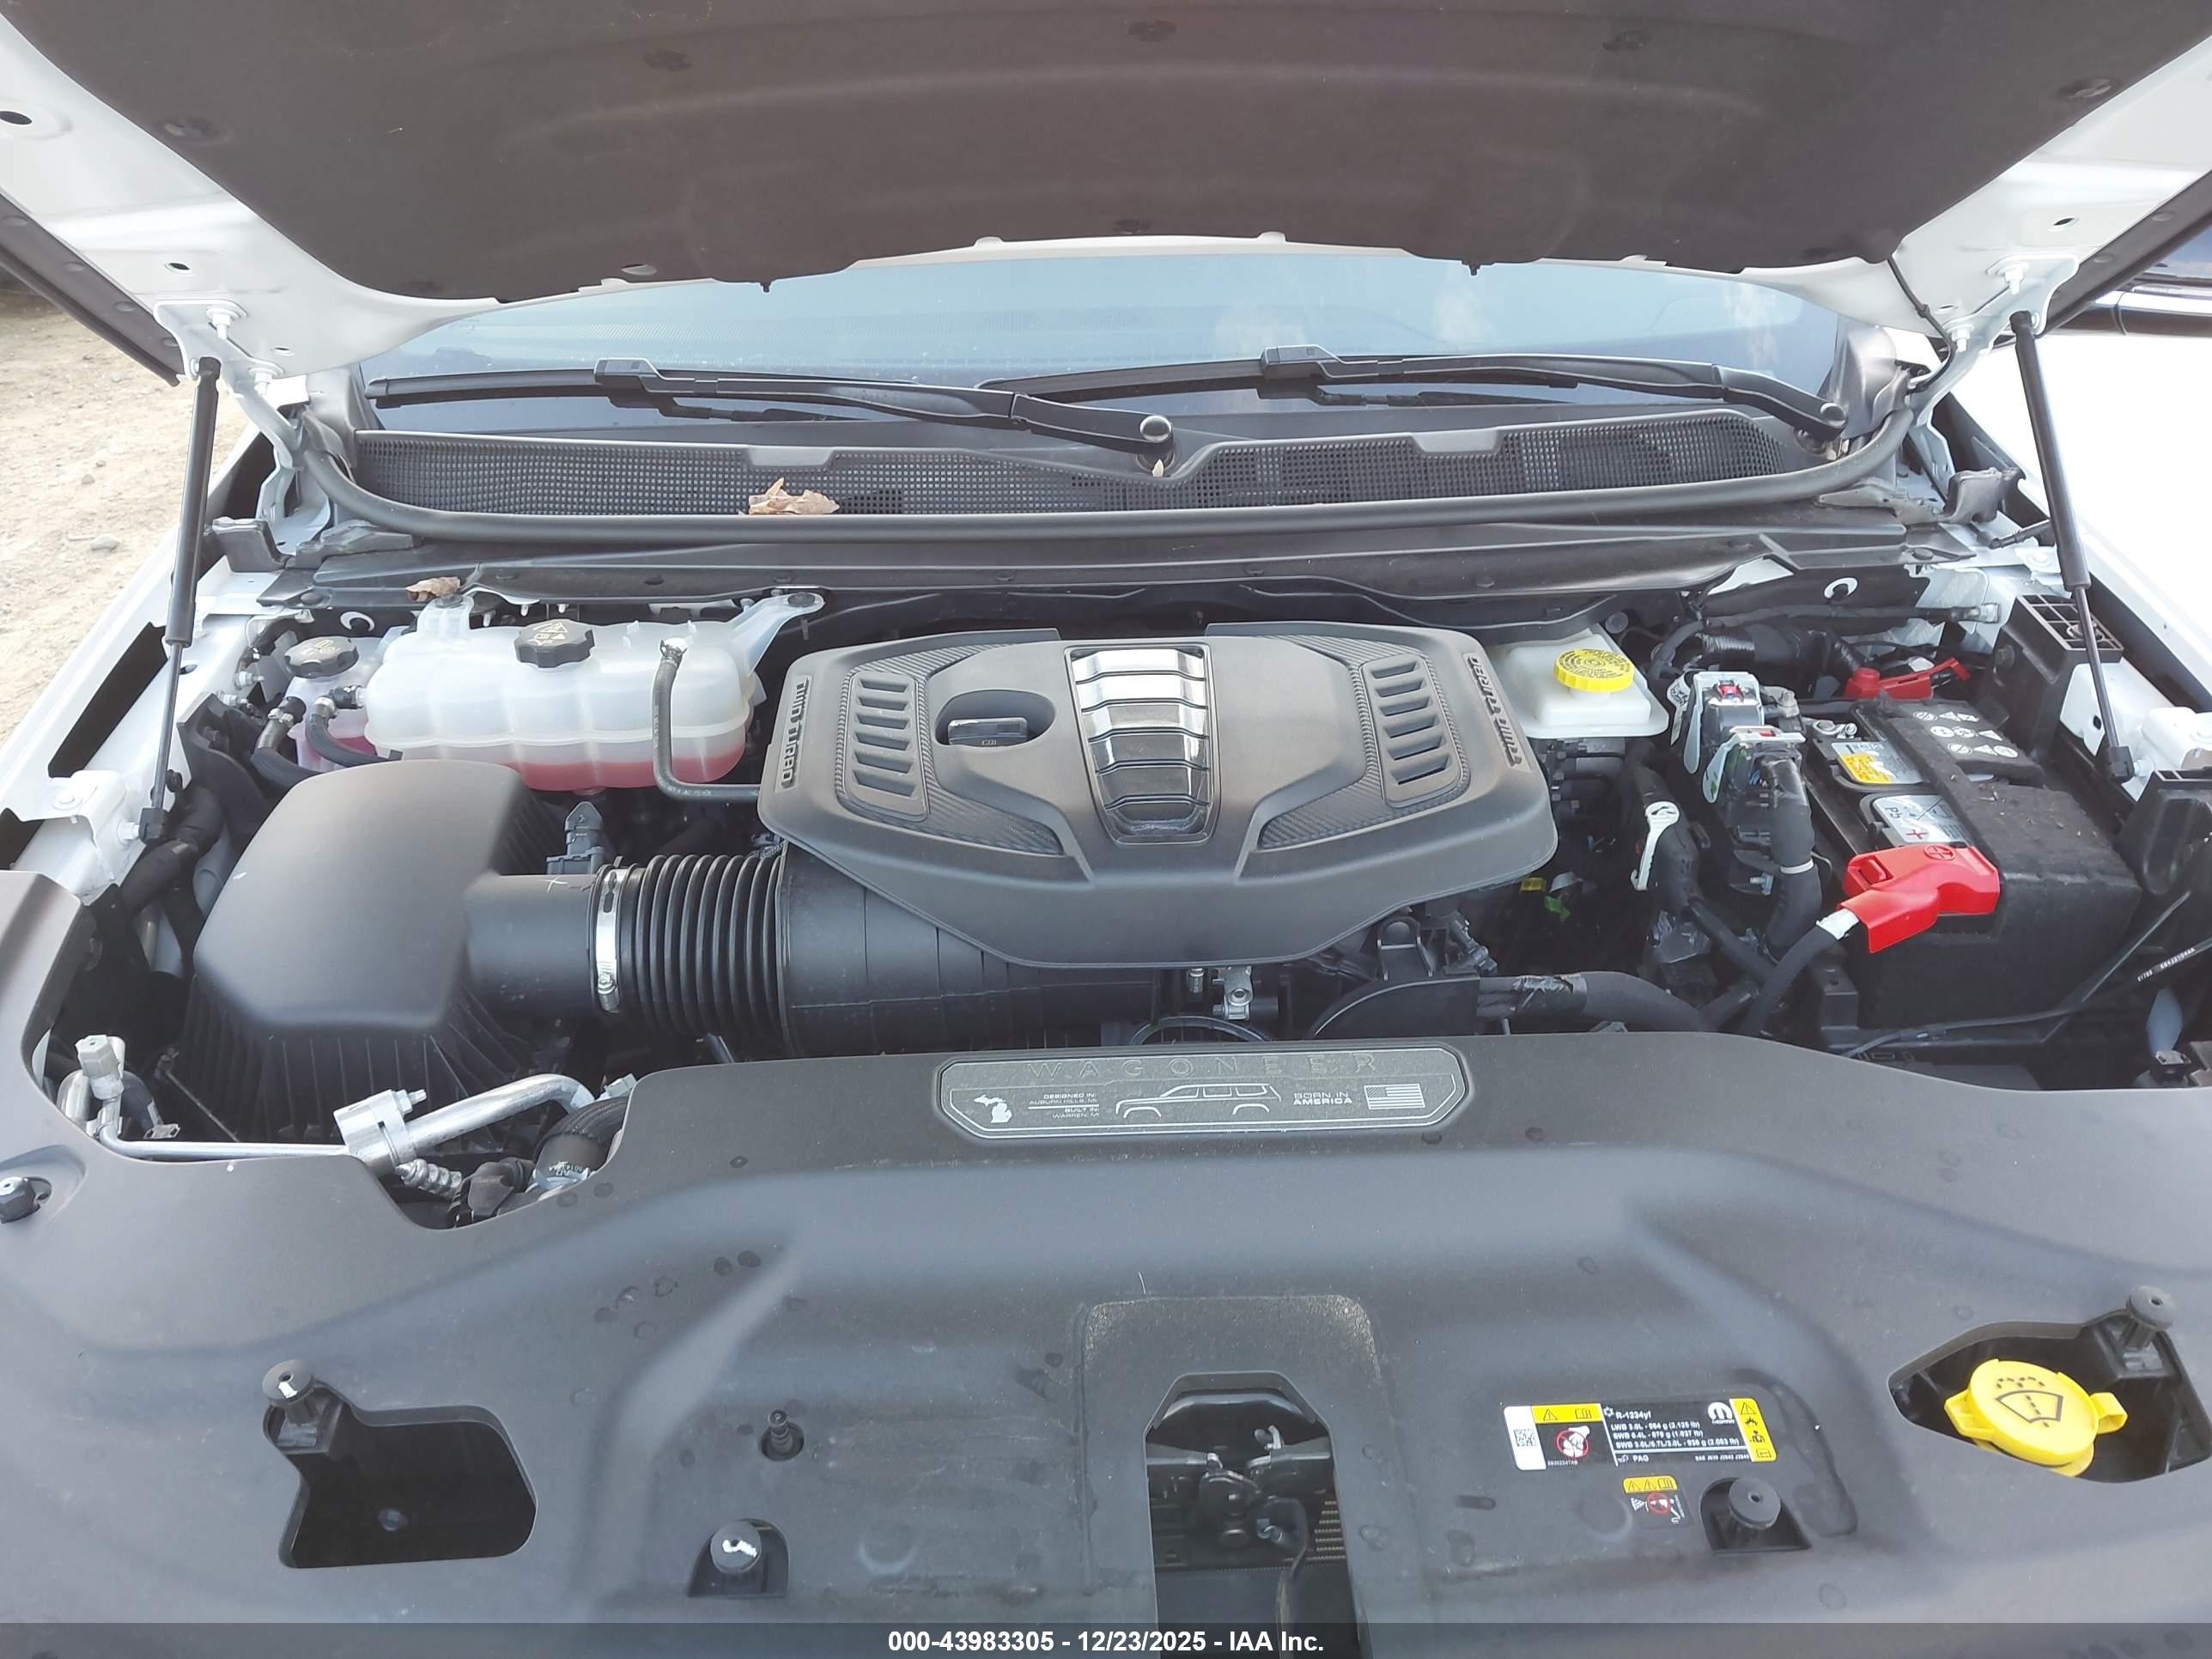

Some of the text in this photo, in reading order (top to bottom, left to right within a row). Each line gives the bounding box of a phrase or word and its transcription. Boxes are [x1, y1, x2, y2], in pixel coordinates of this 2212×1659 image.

[1468, 655, 1522, 766] TWIN TURBO
[781, 721, 801, 787] TURBO
[1030, 1054, 1376, 1079] WAGONEER
[1616, 1410, 1651, 1420] R-1234yf
[1615, 1440, 1633, 1449] SWB
